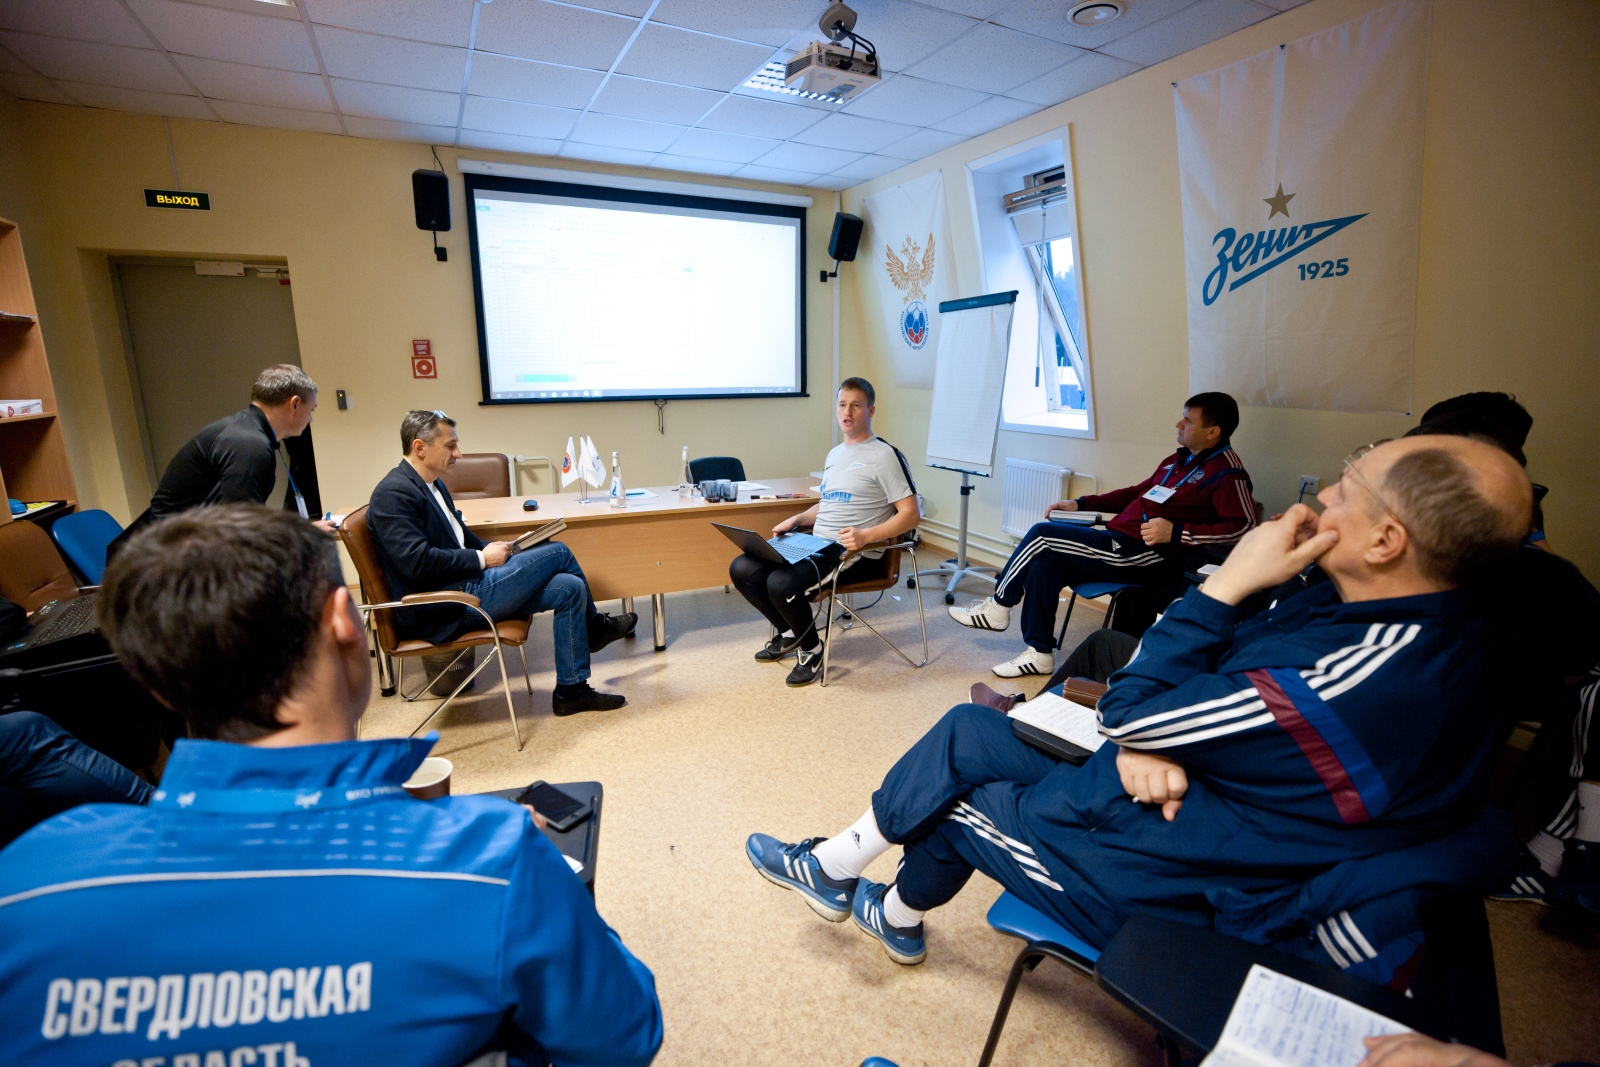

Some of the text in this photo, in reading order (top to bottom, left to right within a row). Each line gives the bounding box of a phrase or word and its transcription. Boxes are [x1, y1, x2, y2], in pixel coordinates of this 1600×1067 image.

[156, 194, 200, 207] ВЫХОД
[1297, 257, 1350, 281] 1925
[41, 961, 373, 1041] СВЕРДЛОВСКАЯ
